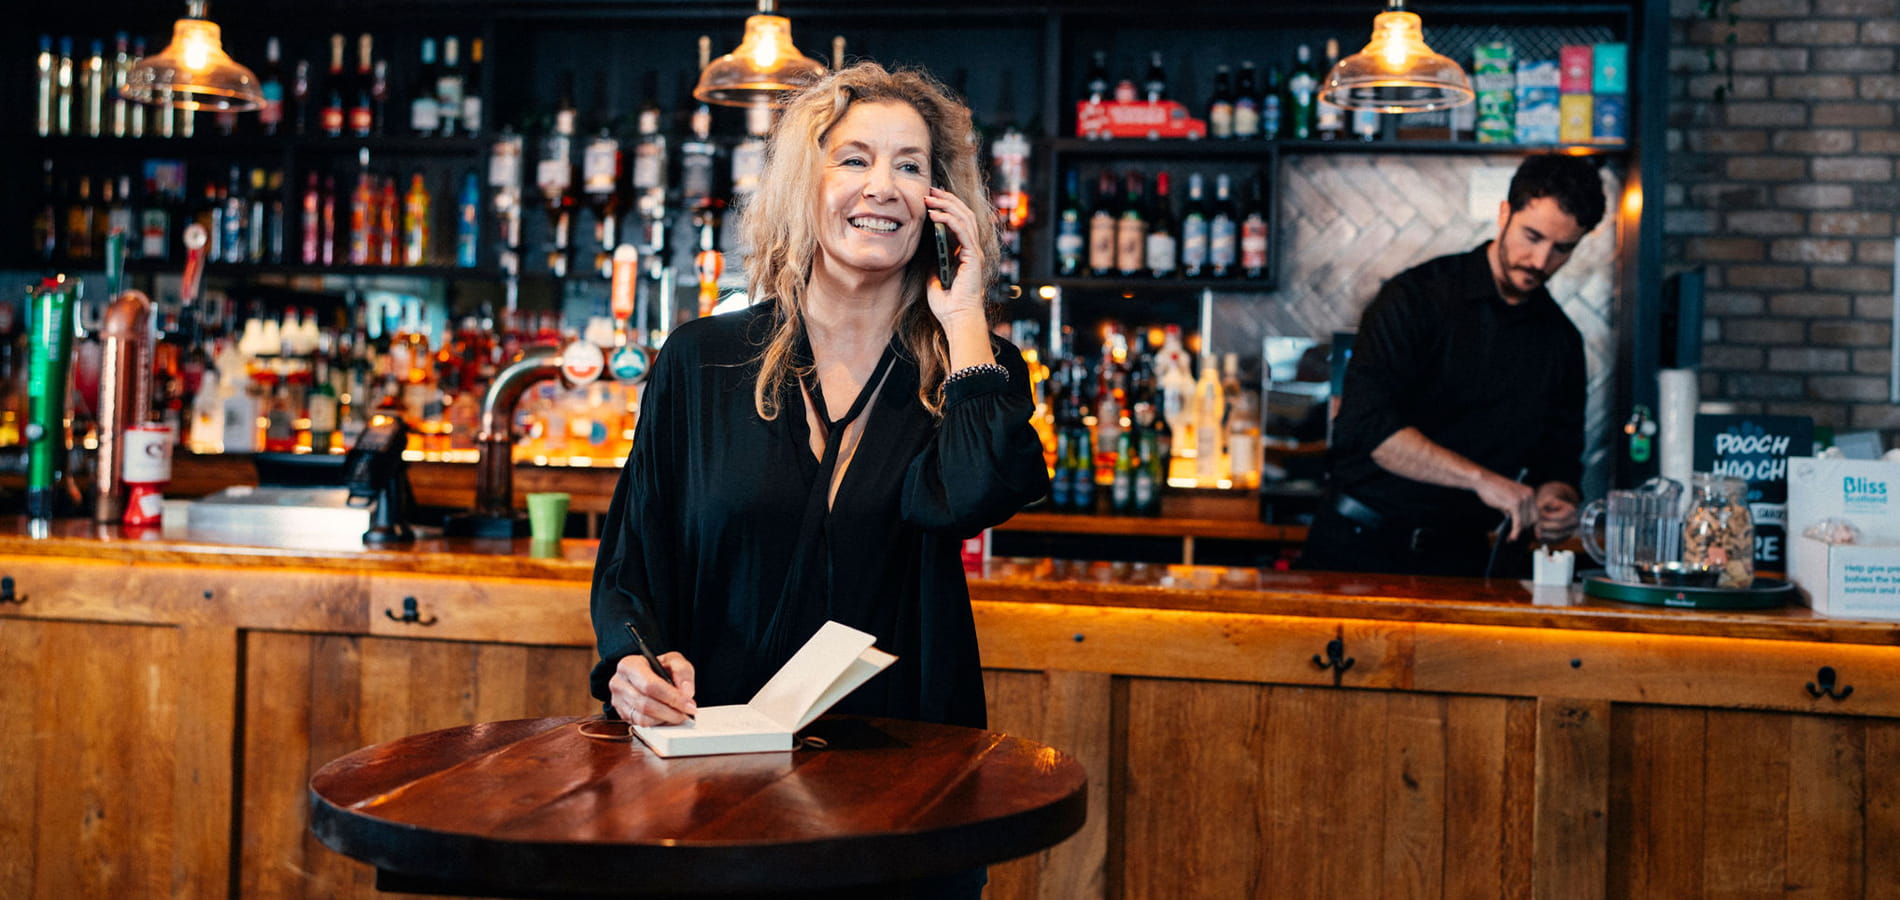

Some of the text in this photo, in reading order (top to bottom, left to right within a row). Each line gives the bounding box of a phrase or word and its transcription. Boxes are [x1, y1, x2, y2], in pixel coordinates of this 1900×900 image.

[1716, 433, 1790, 455] POOCH
[1843, 476, 1887, 494] Bliss
[1844, 565, 1864, 574] Help
[1875, 575, 1889, 584] the
[1879, 586, 1896, 595] and
